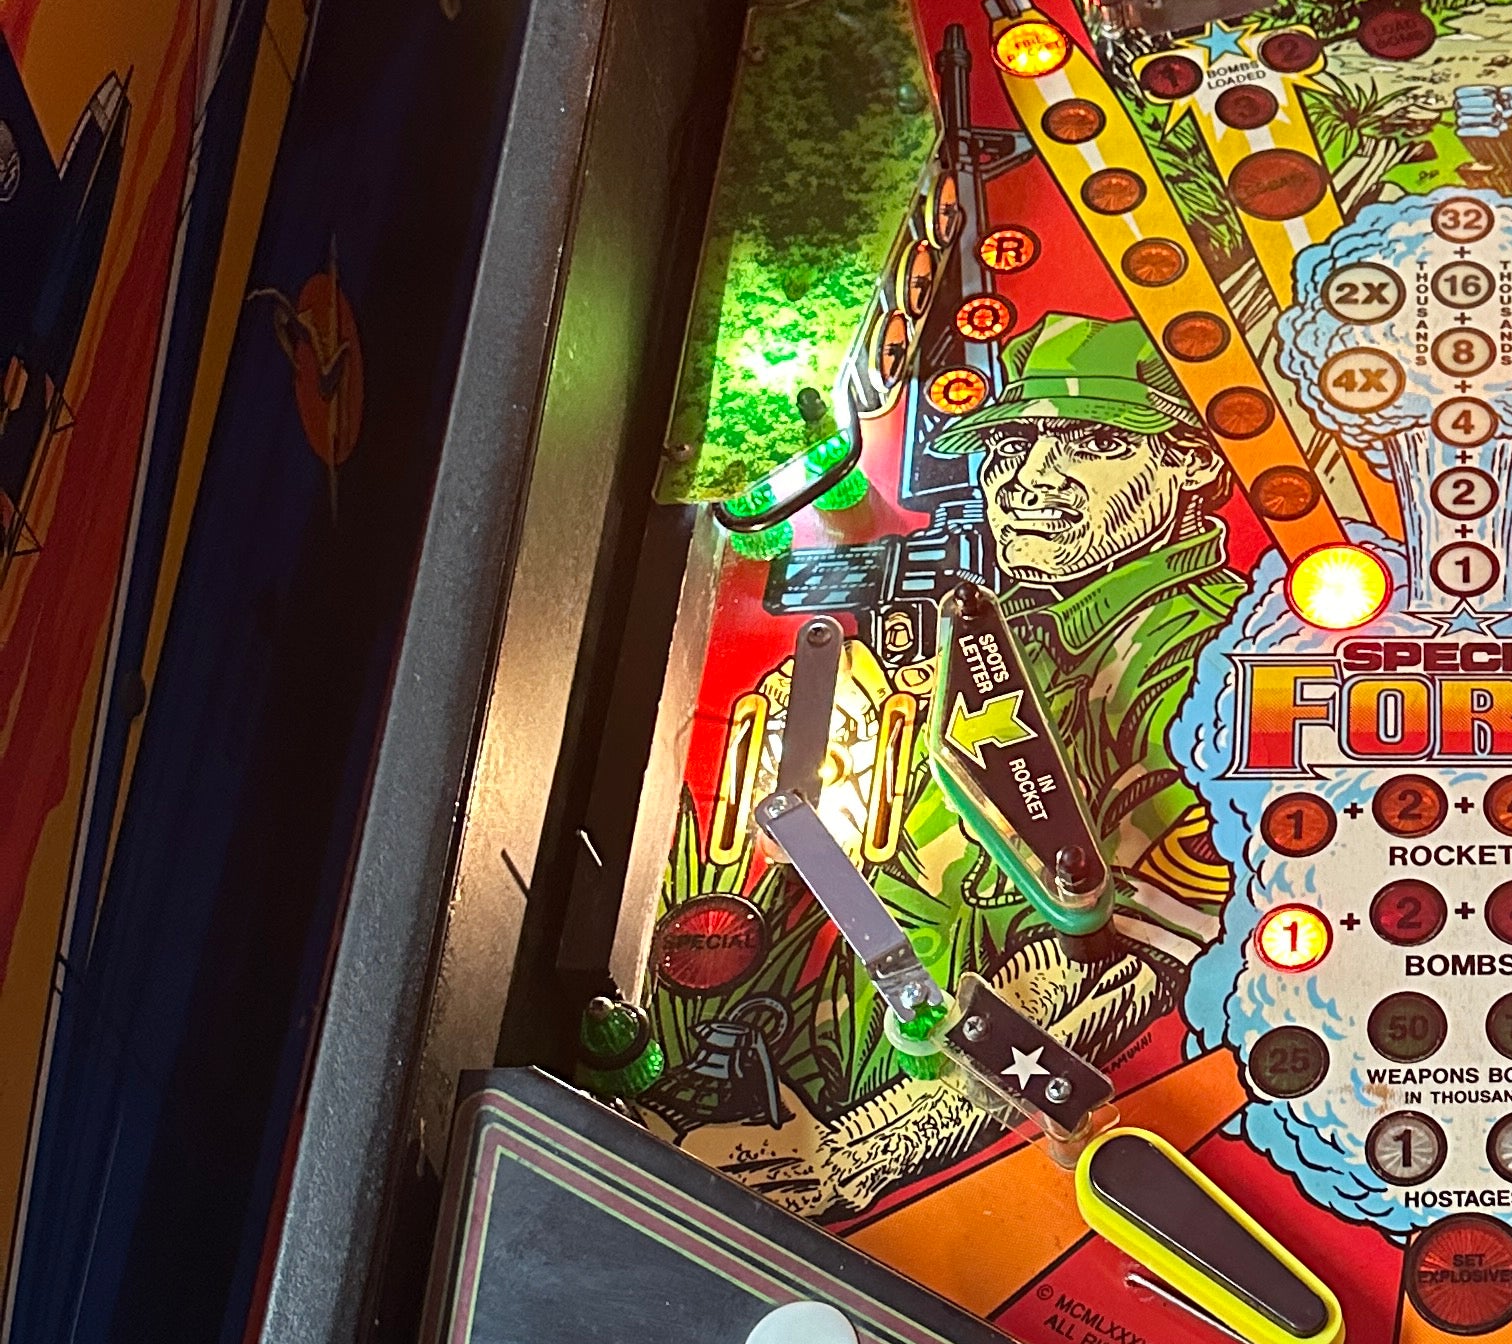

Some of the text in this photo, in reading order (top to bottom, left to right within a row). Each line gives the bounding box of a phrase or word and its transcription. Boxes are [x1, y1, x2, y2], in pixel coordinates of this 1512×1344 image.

[1206, 60, 1260, 80] BOMBS
[1206, 69, 1267, 91] LOADED
[1440, 209, 1483, 230] 32
[1335, 282, 1393, 305] 2X
[1443, 273, 1482, 298] 16
[942, 236, 1026, 405] R O C
[1416, 260, 1429, 367] THOUSANDS
[1499, 259, 1512, 366] THOUSANDS
[1452, 339, 1474, 364] 8
[1332, 368, 1389, 393] 4X
[1450, 409, 1475, 434] 4
[1453, 479, 1476, 506] 2
[1455, 557, 1471, 583] 1
[957, 634, 995, 695] LETTER
[977, 632, 1011, 686] SPOTS
[1007, 758, 1051, 823] ROCKET
[1037, 773, 1058, 794] IN
[1290, 810, 1305, 838] 1
[1398, 791, 1423, 820] 2
[1283, 922, 1300, 952] 1
[1397, 897, 1423, 929] 2
[662, 933, 756, 950] SPECIAL
[1387, 1013, 1429, 1042] 50
[1366, 1067, 1480, 1085] WEAPONS
[1403, 1090, 1421, 1104] IN
[1398, 1129, 1414, 1168] 1
[1453, 1253, 1486, 1267] SET
[1043, 1313, 1076, 1342] ALL
